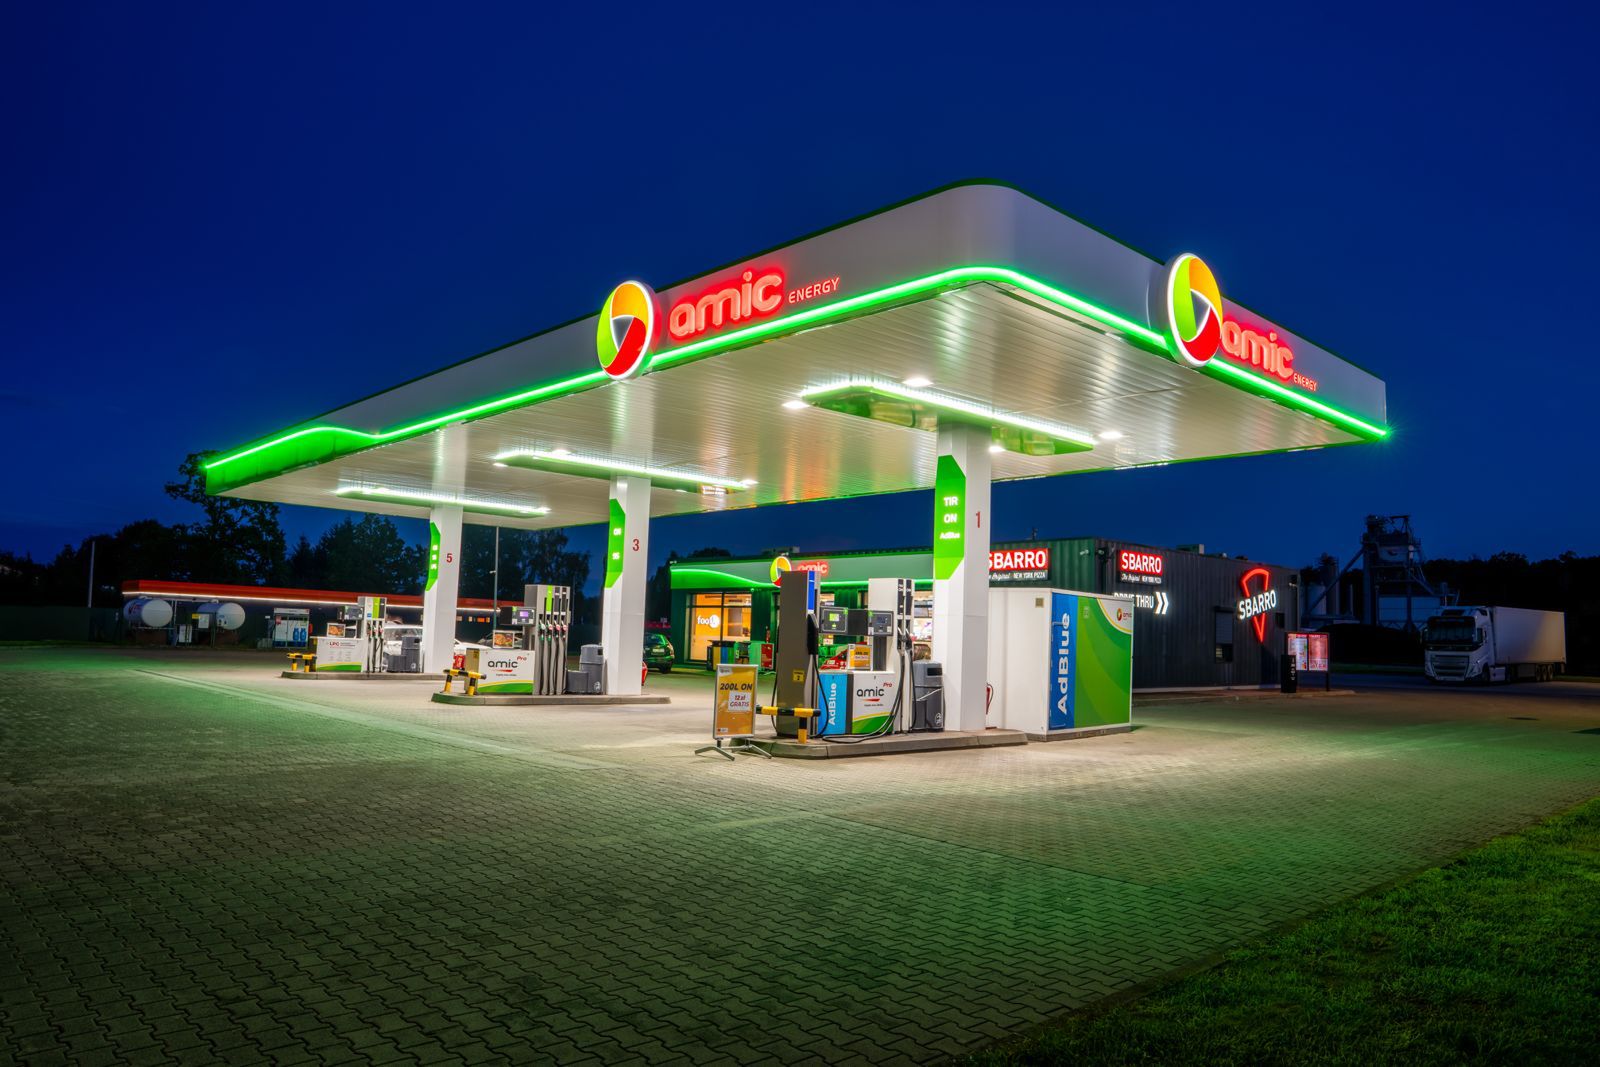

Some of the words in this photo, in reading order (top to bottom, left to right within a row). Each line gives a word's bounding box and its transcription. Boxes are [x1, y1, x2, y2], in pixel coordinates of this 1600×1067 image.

[669, 271, 783, 337] amic
[788, 277, 840, 304] ENERGY
[1221, 321, 1294, 378] amic
[1293, 372, 1318, 392] ENERGY
[943, 496, 958, 506] TIR
[944, 513, 957, 523] ON
[975, 511, 981, 529] 1
[632, 538, 640, 552] 3
[446, 552, 453, 563] 5
[1122, 552, 1162, 573] SBARRO
[1135, 594, 1155, 609] THRU
[1239, 590, 1276, 620] SBARRO
[487, 658, 519, 669] amic
[1057, 612, 1071, 716] AdBlue
[719, 683, 739, 691] 200L
[740, 683, 753, 691] ON
[856, 686, 885, 698] amic
[828, 683, 837, 726] AdBlue
